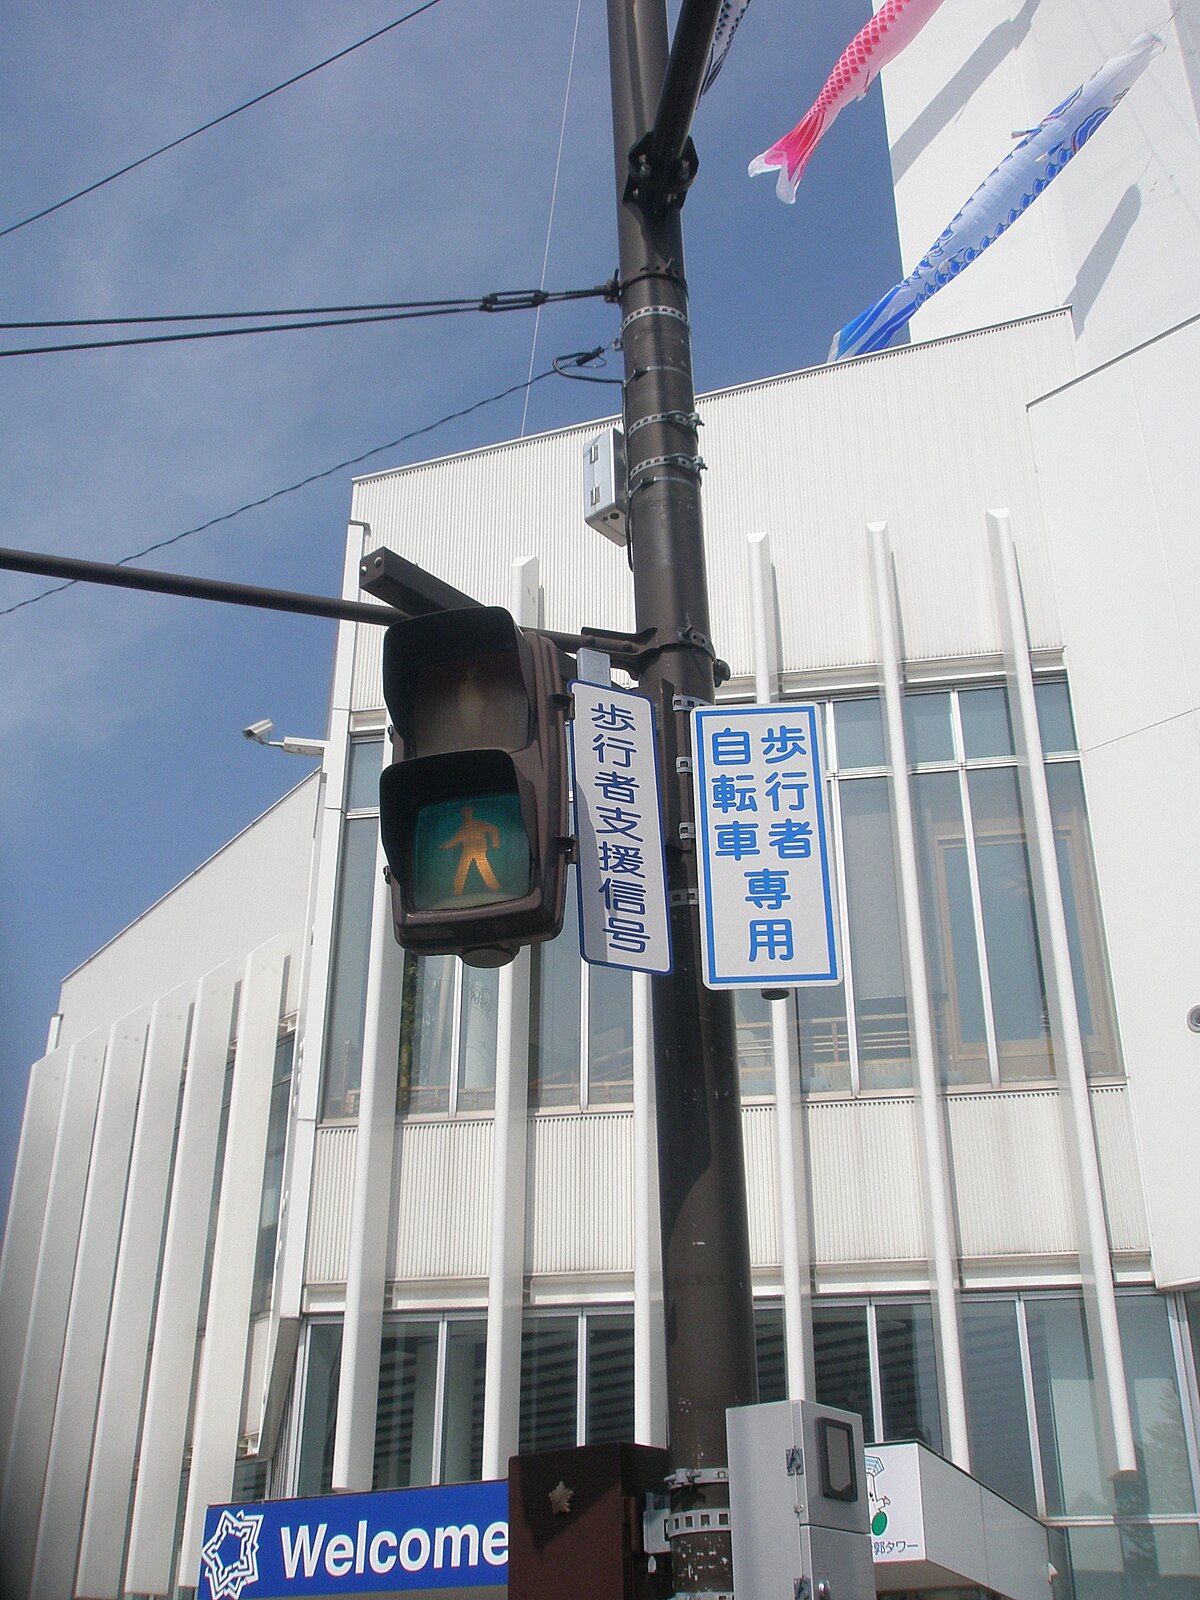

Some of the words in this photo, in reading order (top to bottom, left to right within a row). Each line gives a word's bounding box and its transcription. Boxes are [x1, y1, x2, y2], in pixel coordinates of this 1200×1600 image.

[590, 702, 651, 954] 歩行者支援信号
[711, 727, 760, 861] 自転車
[761, 725, 813, 859] 歩行者
[743, 868, 795, 962] 専用
[280, 1519, 508, 1579] Welcome
